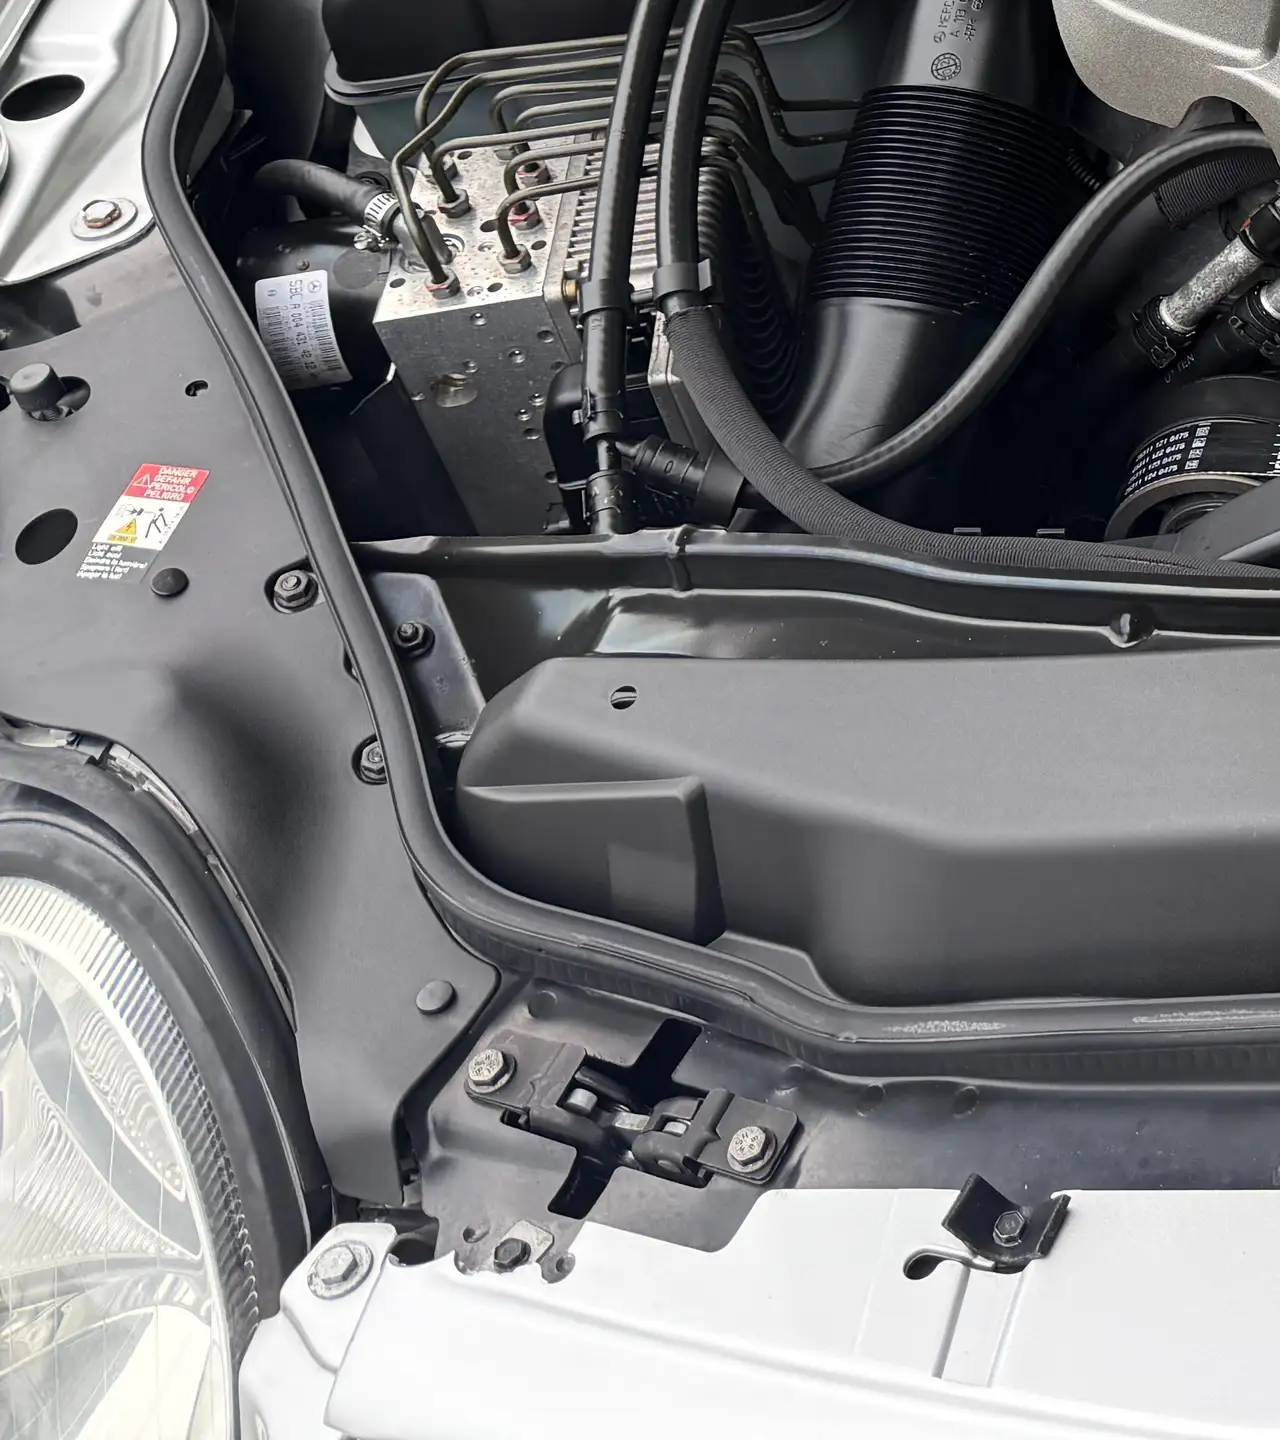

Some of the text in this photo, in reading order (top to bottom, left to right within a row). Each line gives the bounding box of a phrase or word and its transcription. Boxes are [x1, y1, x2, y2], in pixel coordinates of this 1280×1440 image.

[159, 466, 199, 478] DANGER
[153, 475, 192, 485] GEFAHR
[149, 482, 196, 494] PERICOLO
[144, 490, 185, 501] PELIGRO
